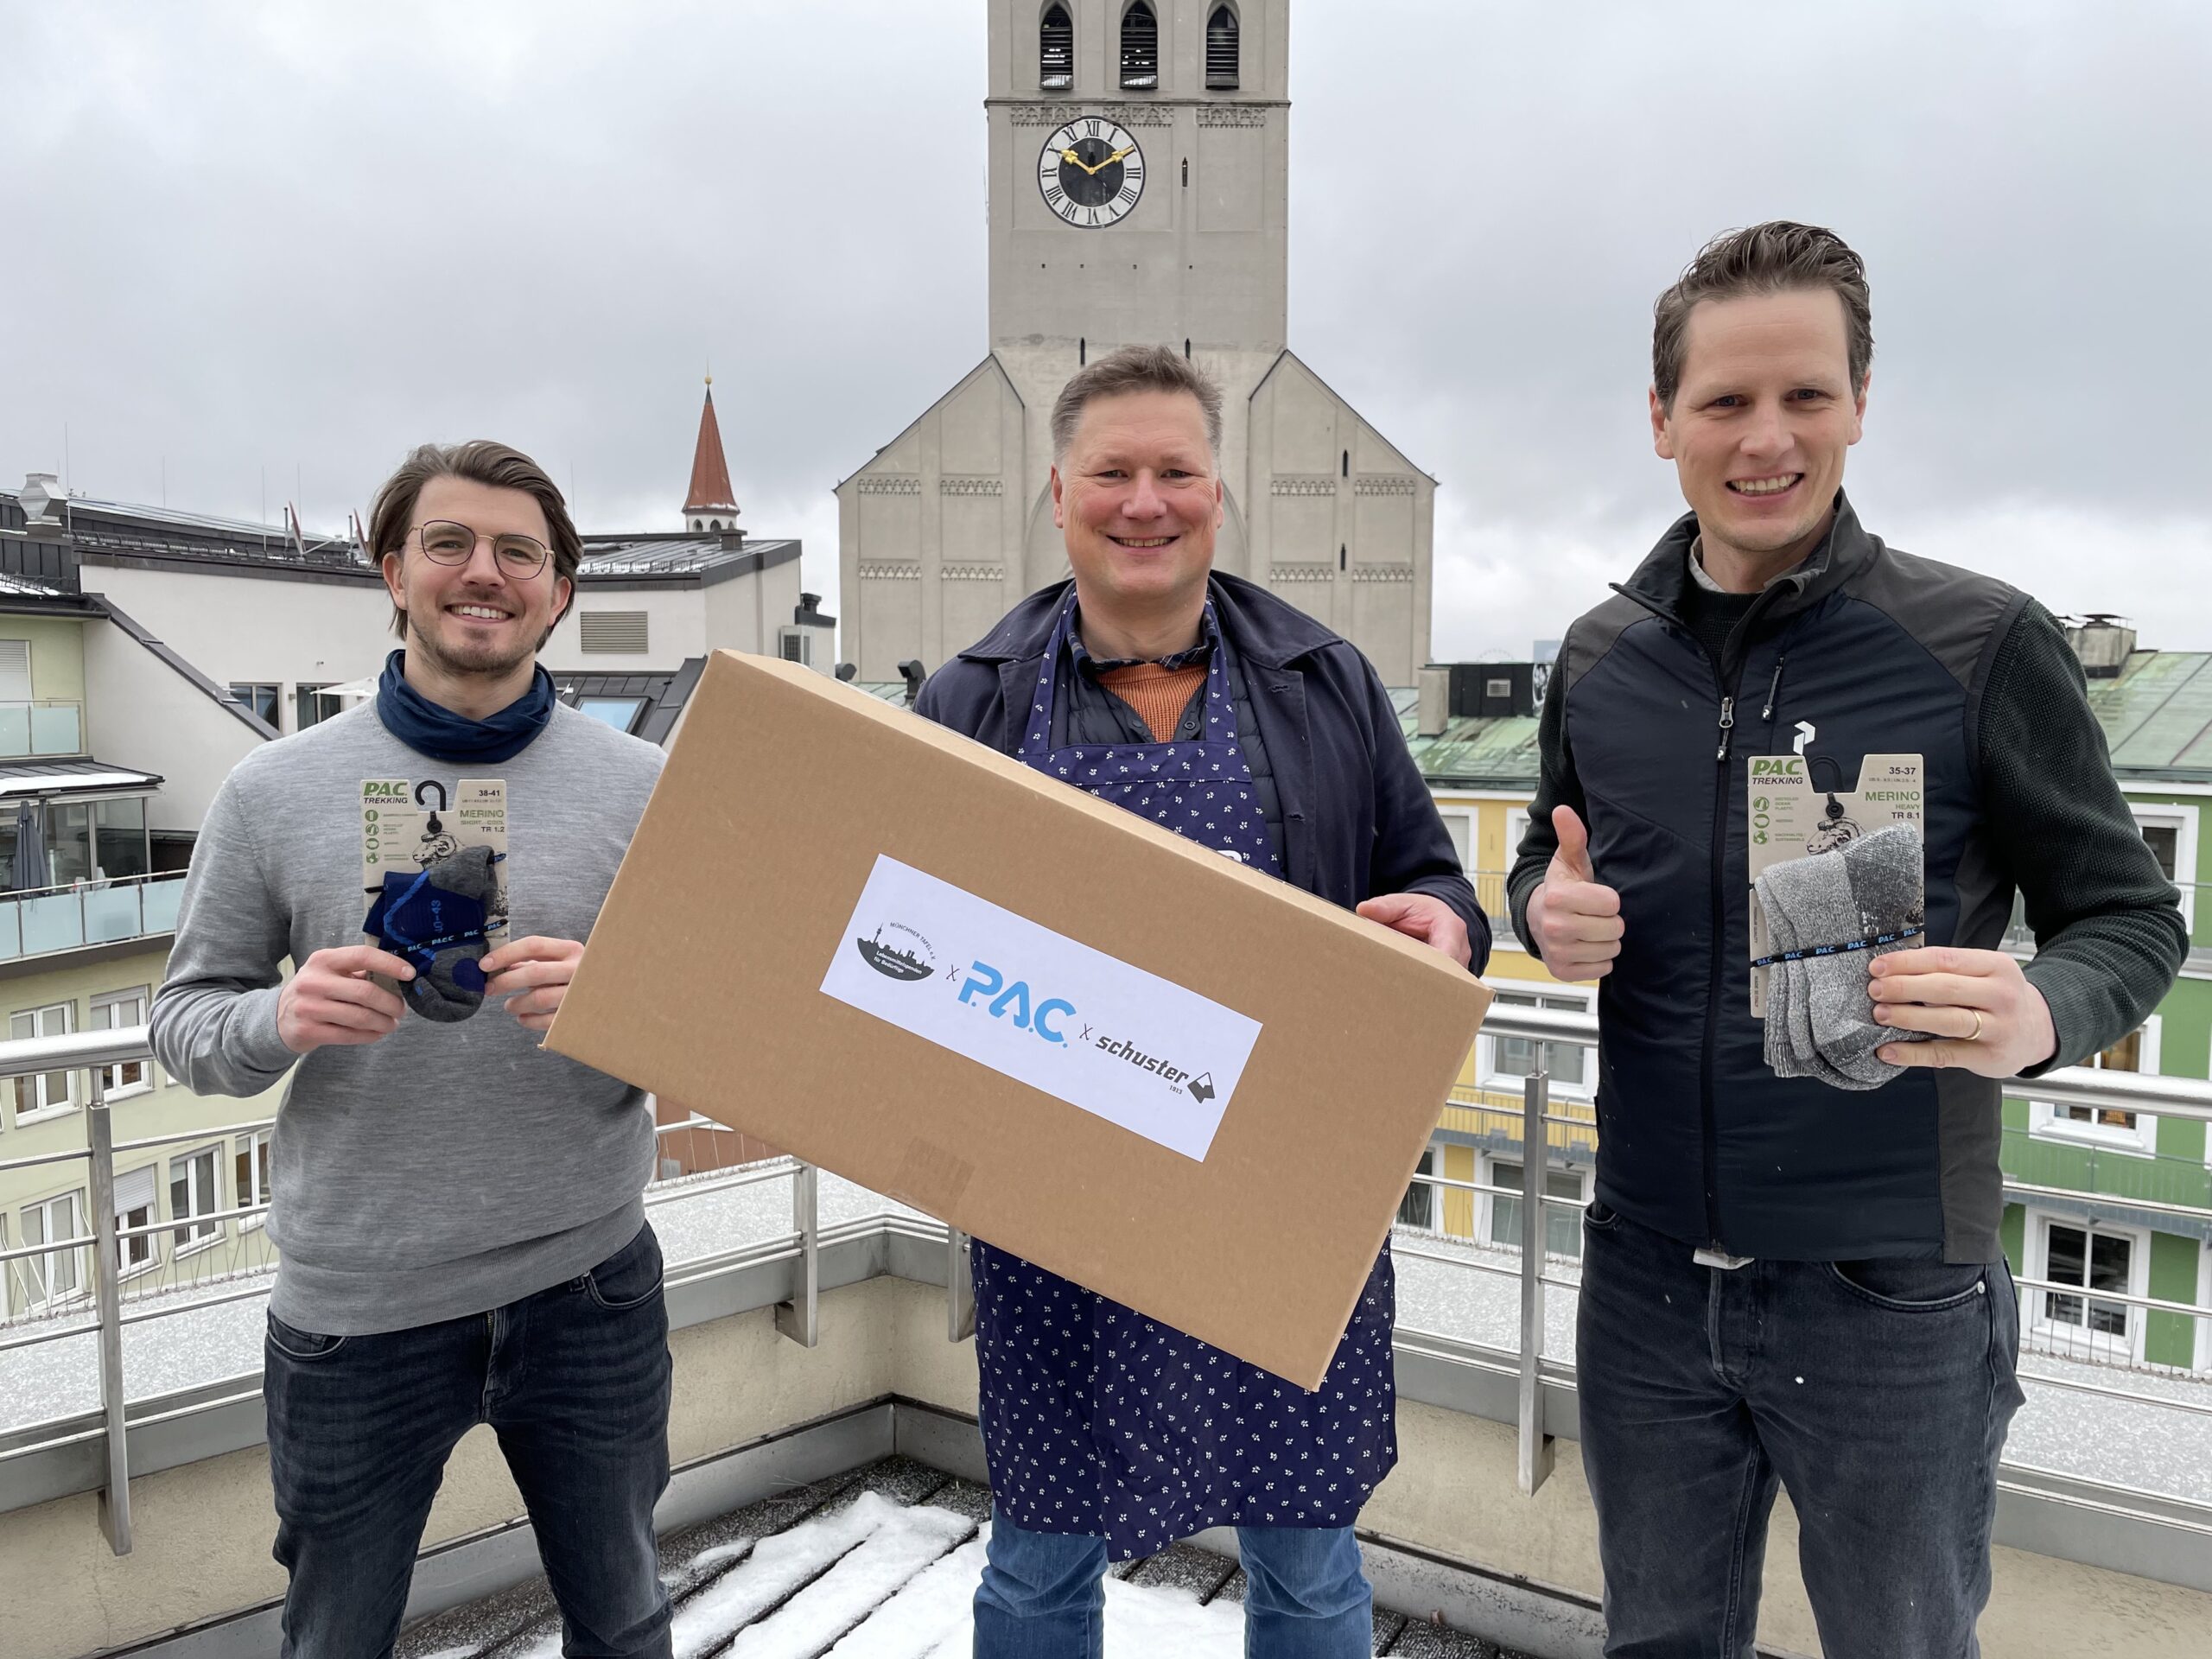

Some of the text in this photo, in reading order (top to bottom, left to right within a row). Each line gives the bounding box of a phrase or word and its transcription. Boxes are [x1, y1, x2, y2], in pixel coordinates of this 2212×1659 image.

[1085, 121, 1102, 137] XII
[1126, 166, 1141, 180] III
[1752, 777, 1803, 785] TREKKING
[1866, 791, 1920, 801] MERINO
[460, 810, 504, 818] MERINO
[890, 922, 920, 938] MÜNCHNER
[920, 936, 932, 951] TAFEL
[876, 950, 922, 975] Lebensmittelspenden
[957, 960, 1077, 1048] P.A.C.
[1095, 1035, 1189, 1084] schuster
[1169, 1084, 1183, 1095] 1913
